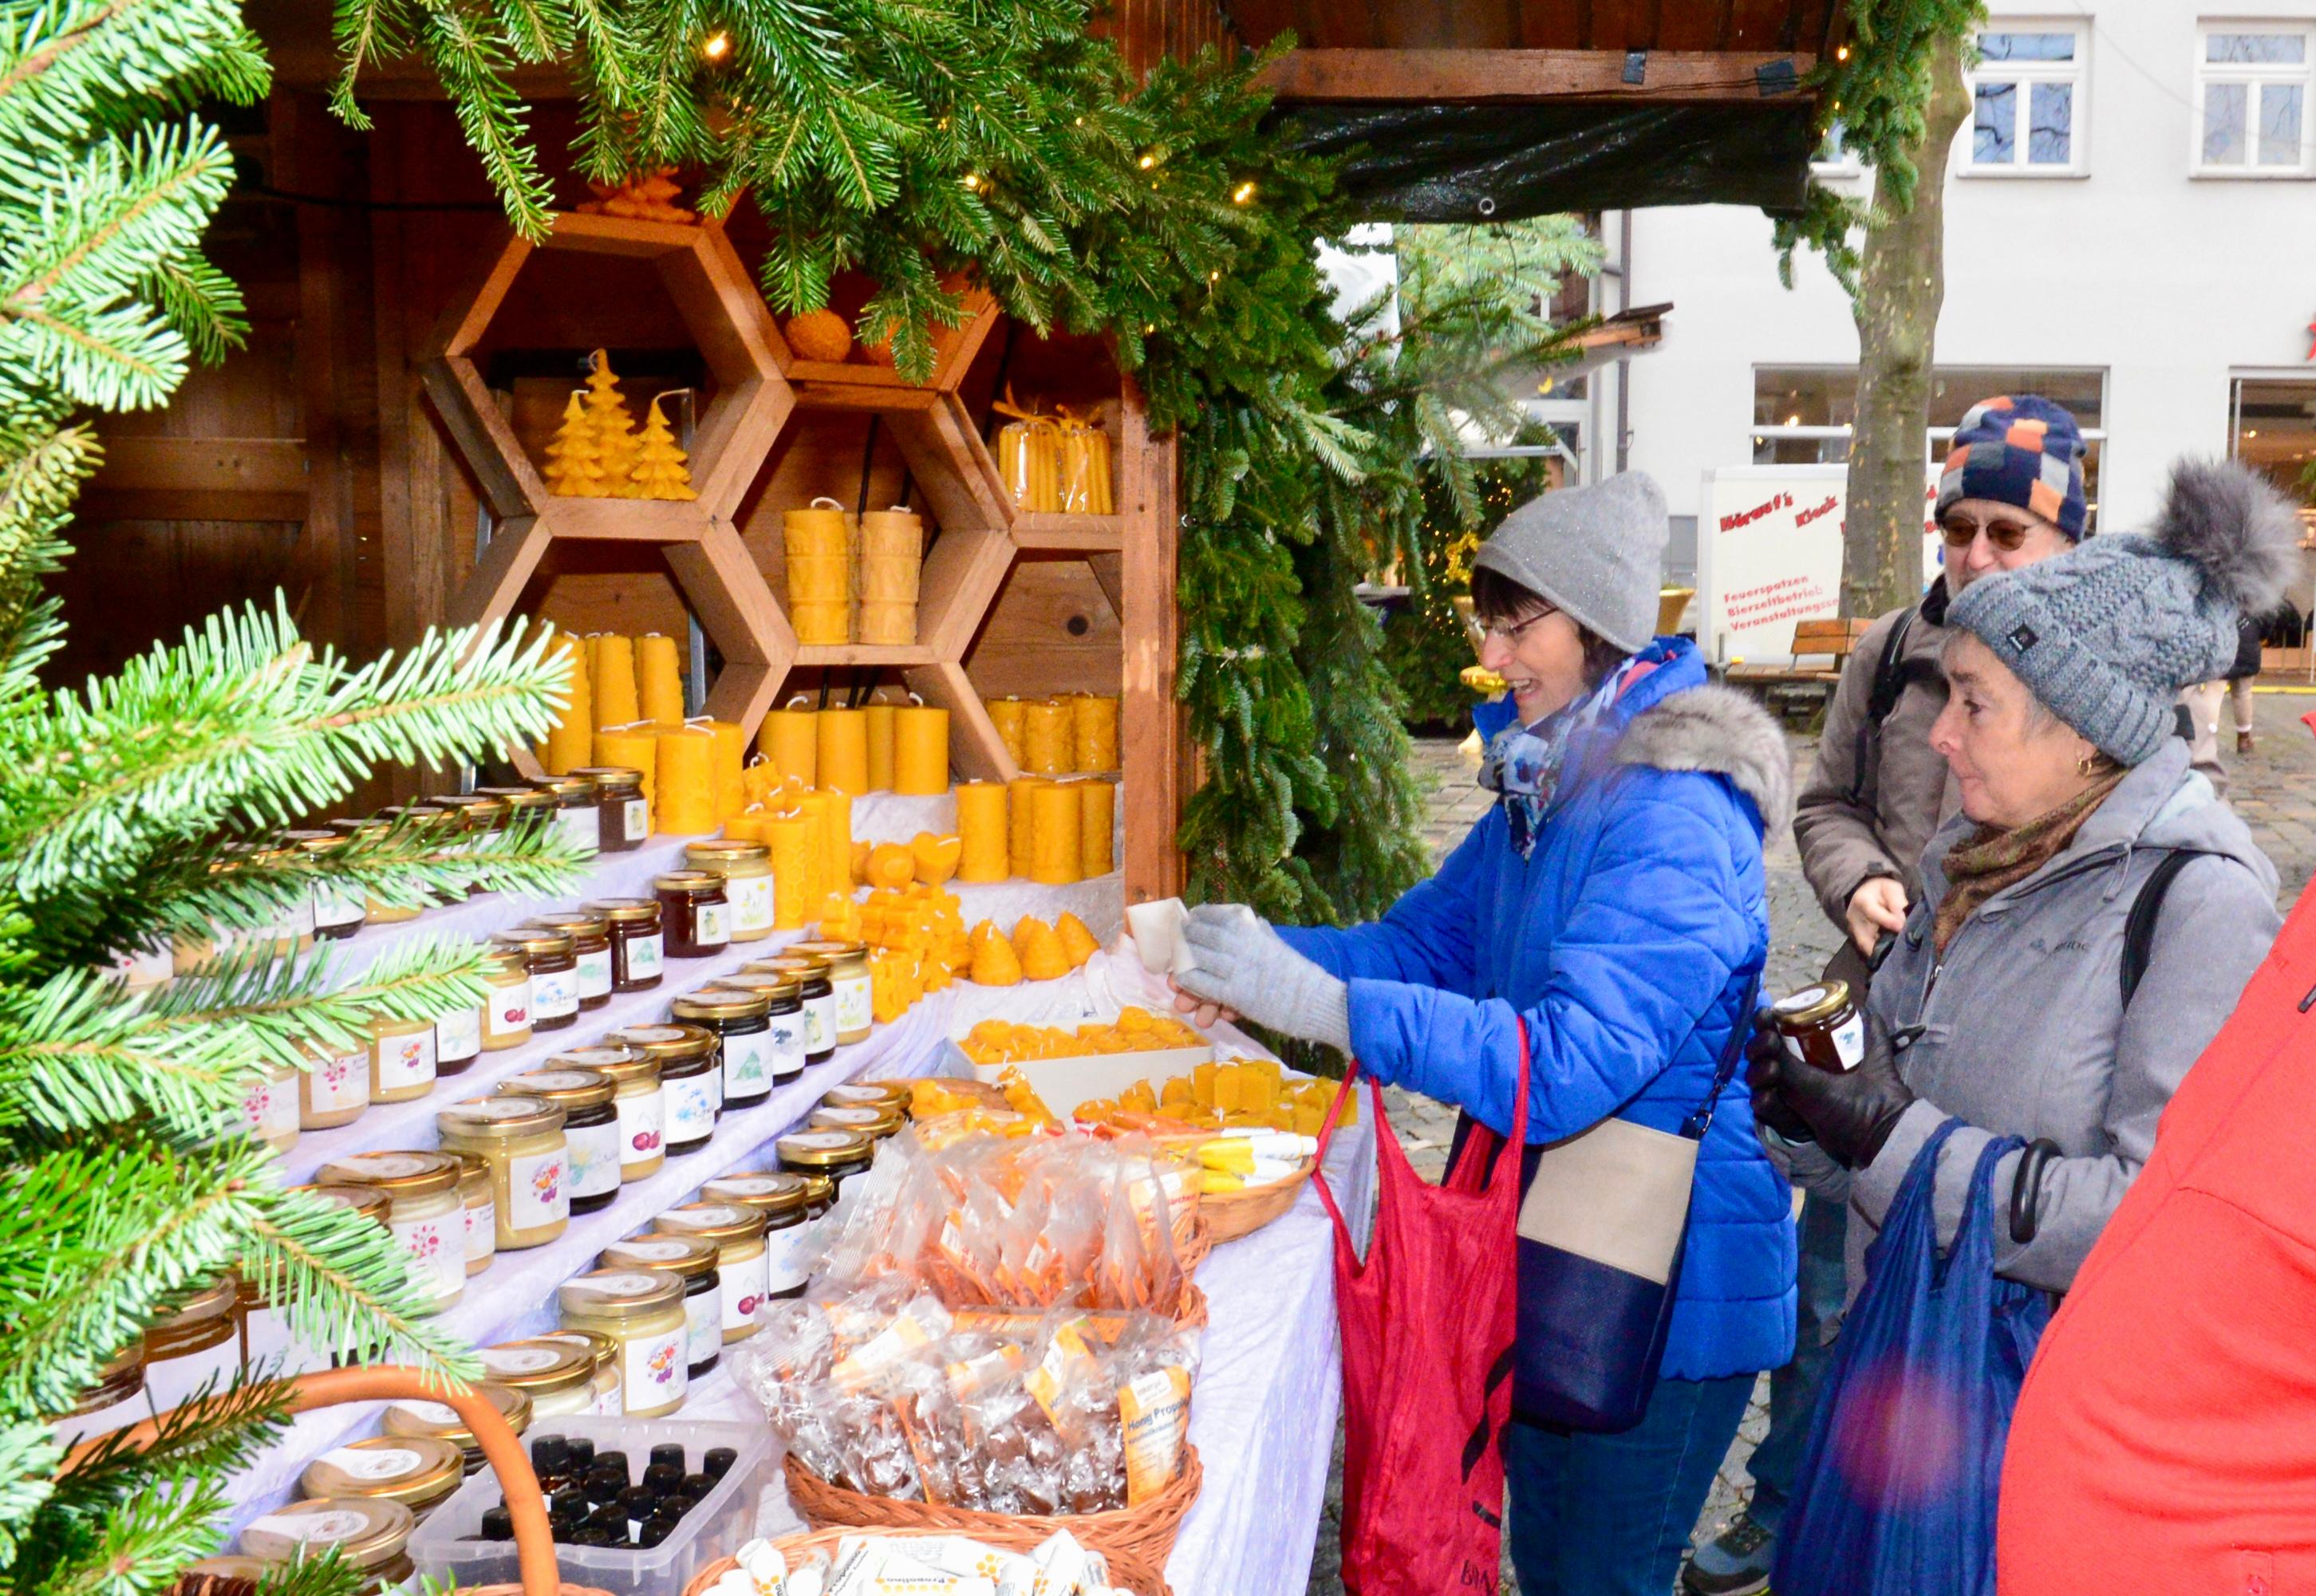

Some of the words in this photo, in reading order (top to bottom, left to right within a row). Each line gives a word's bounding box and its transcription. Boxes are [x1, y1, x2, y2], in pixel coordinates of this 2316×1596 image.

[1723, 575, 1809, 604] Feuerspatzen
[1727, 585, 1824, 618] Bierzeltbetrieb
[1127, 1413, 1154, 1431] Honig
